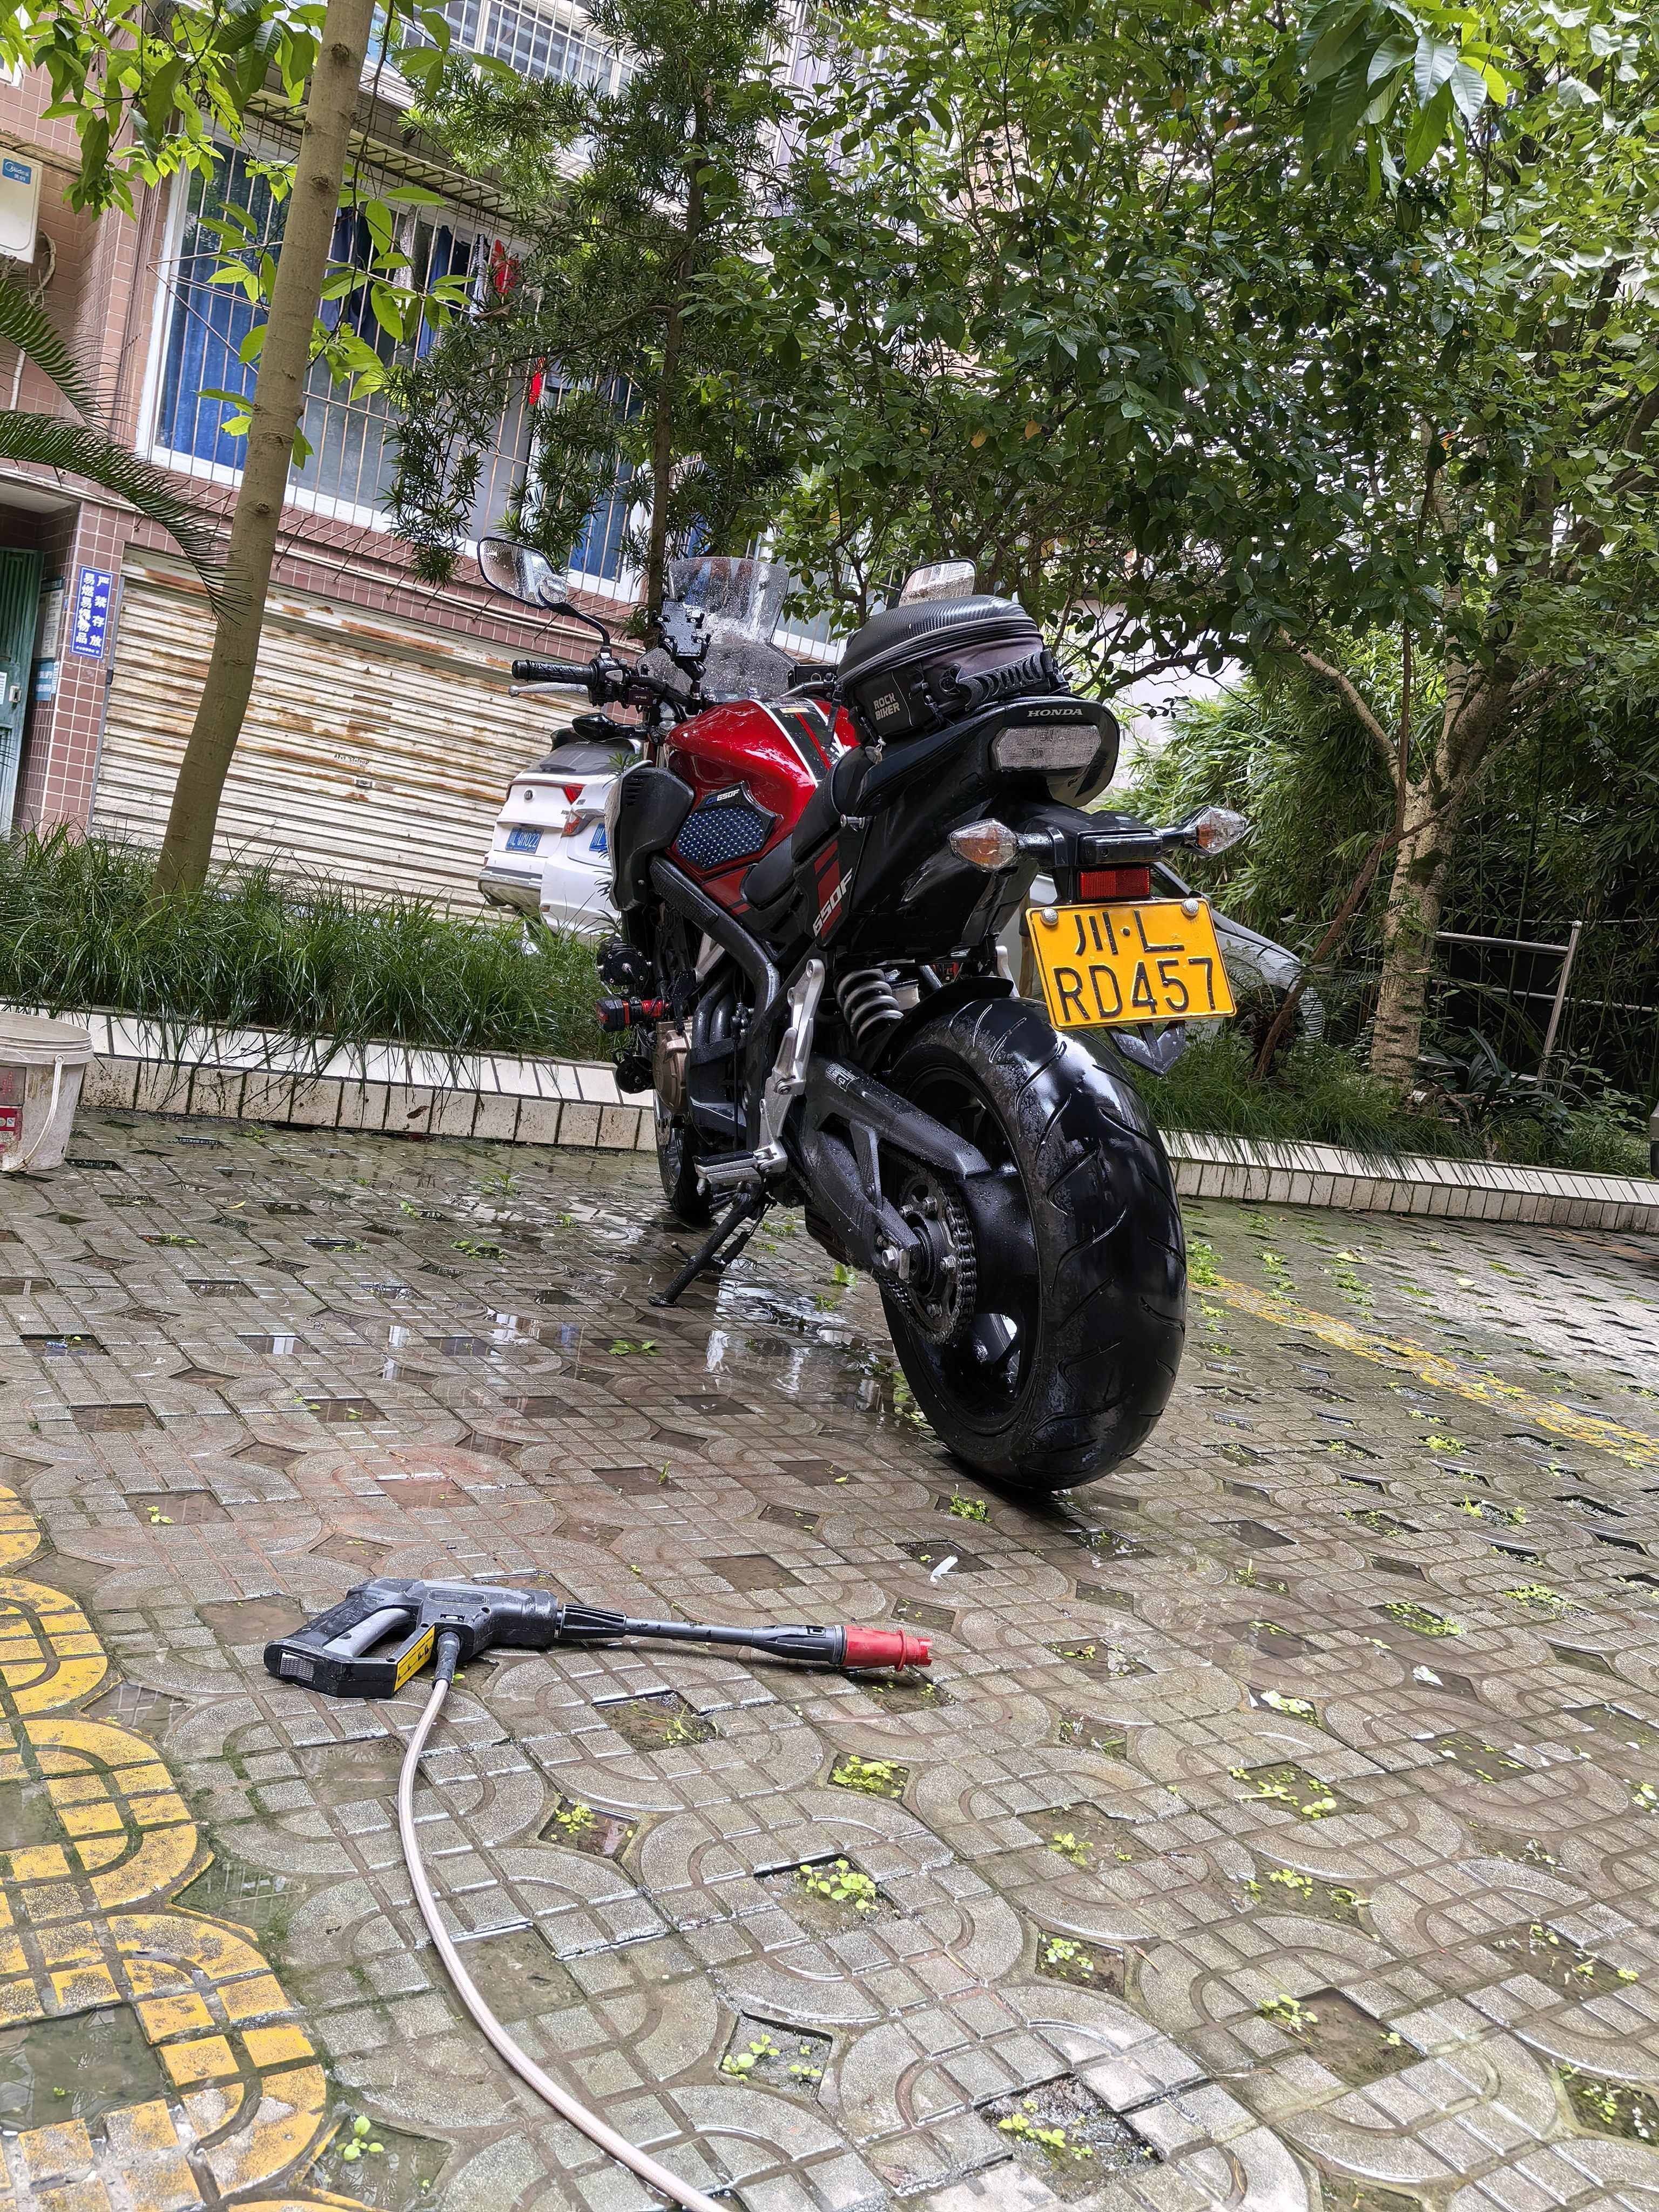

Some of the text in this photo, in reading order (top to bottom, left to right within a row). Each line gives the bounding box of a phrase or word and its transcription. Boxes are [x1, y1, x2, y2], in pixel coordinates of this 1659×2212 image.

[75, 572, 95, 645] 易燃易爆物品
[89, 576, 110, 648] 严禁存放
[873, 692, 896, 710] ROCK
[875, 702, 900, 721] BIKER
[1027, 709, 1083, 718] HONDA
[812, 867, 853, 938] 650F
[1053, 957, 1216, 1022] RD457
